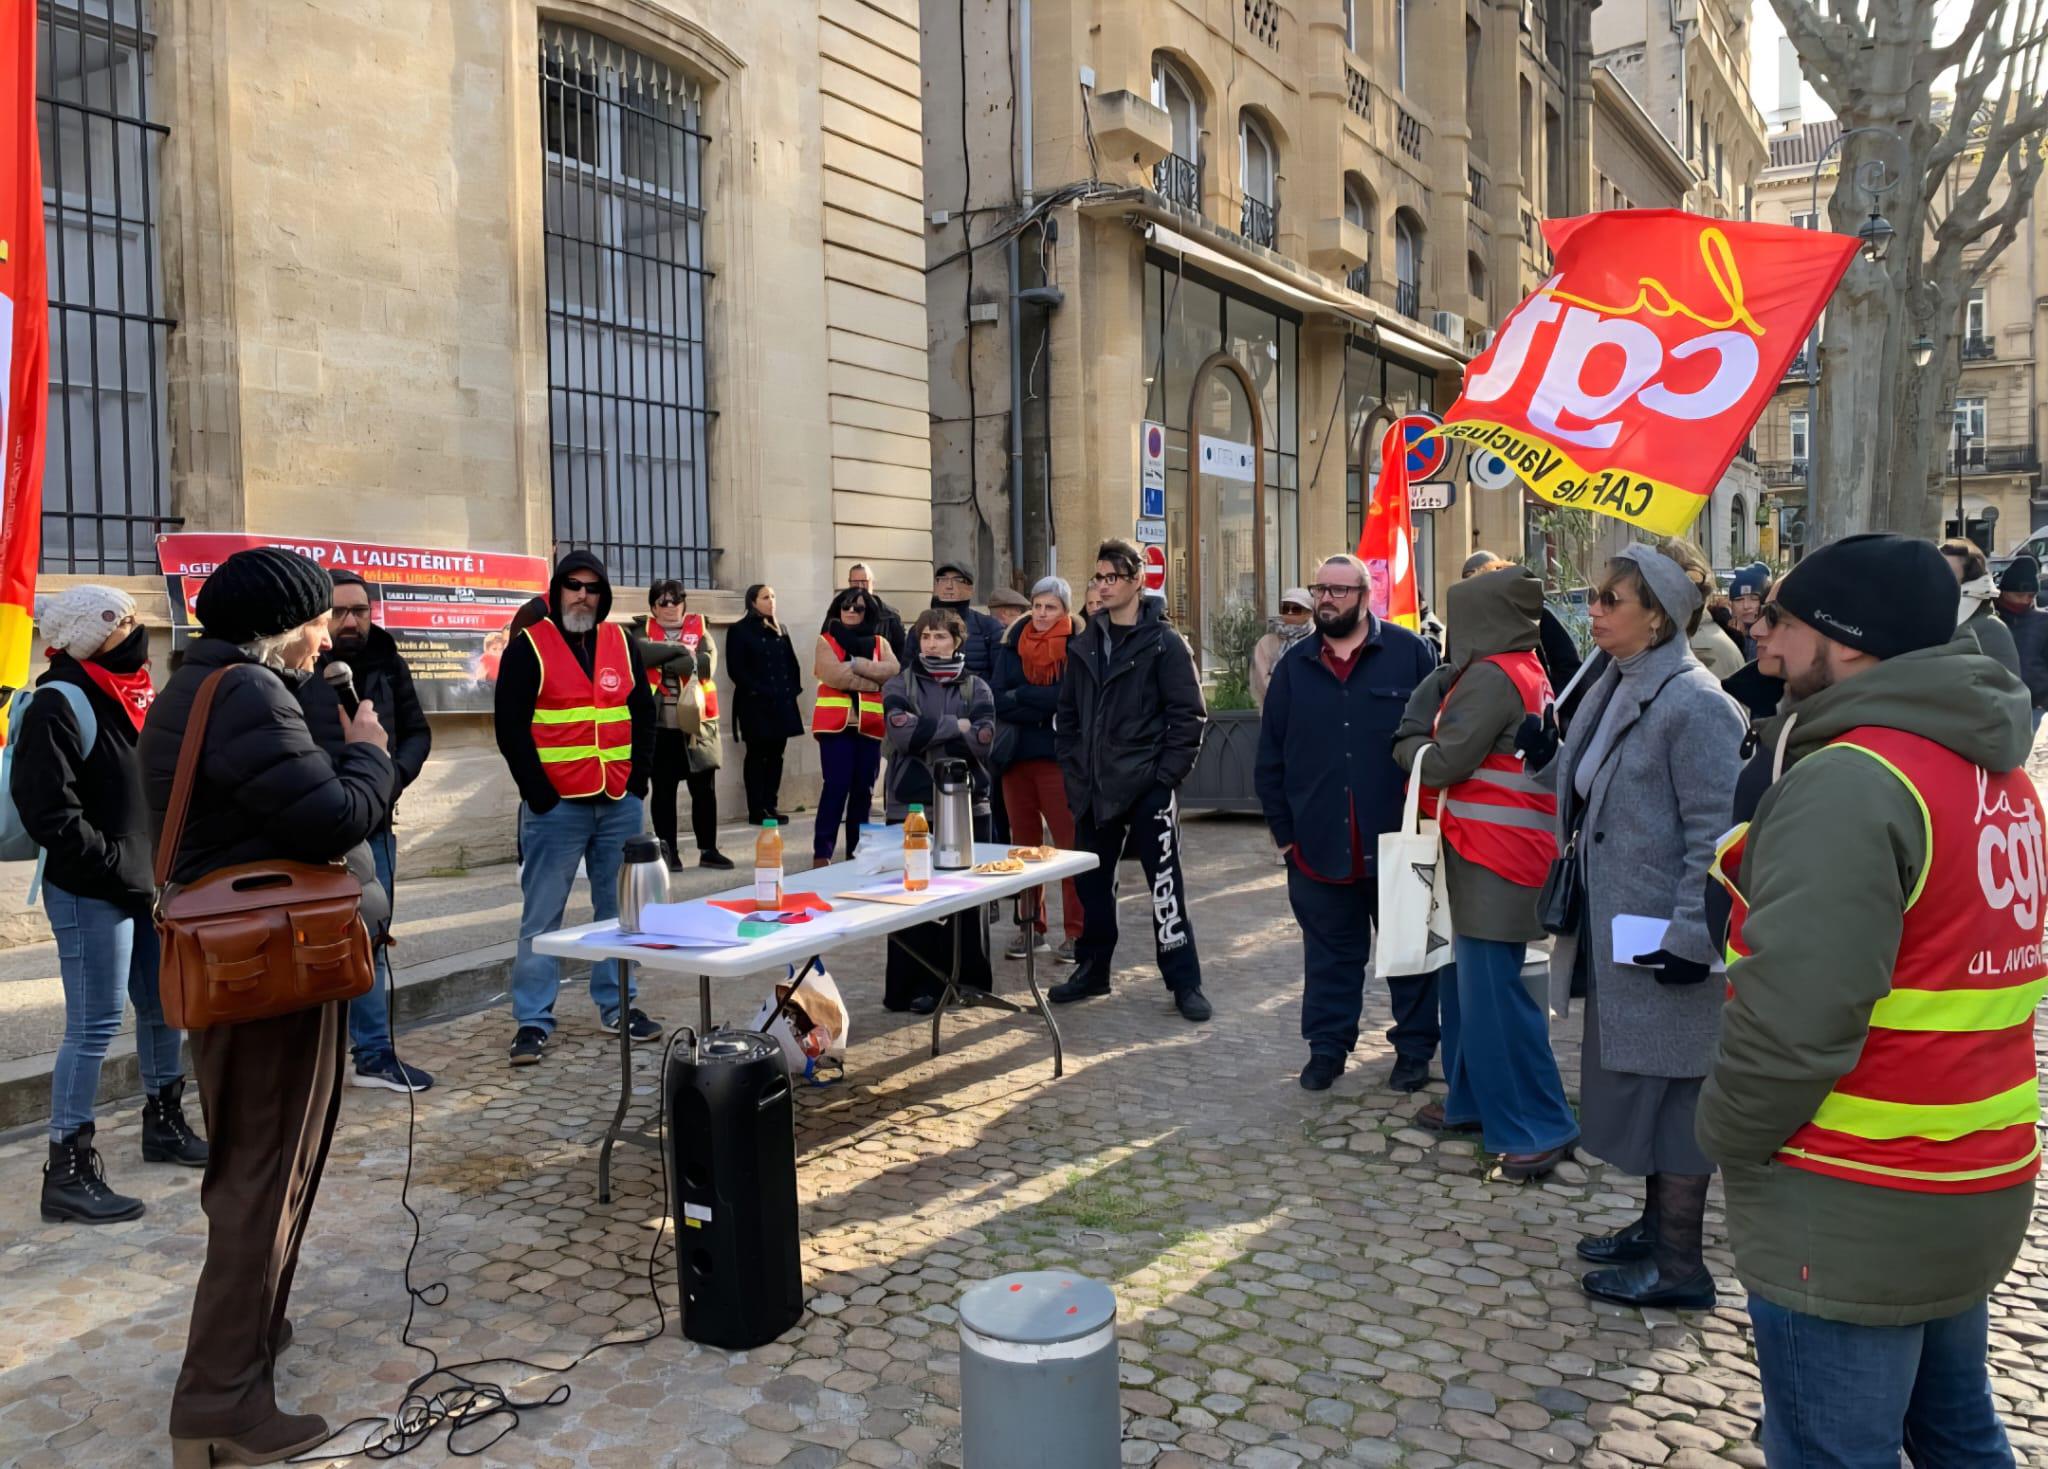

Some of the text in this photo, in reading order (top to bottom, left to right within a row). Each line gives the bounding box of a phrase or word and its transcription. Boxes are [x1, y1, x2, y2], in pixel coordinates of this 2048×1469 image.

[332, 544, 347, 564] À
[352, 550, 475, 572] L'AUSTÉRITÉ
[479, 559, 485, 572] !
[1977, 798, 2047, 930] cgt
[1968, 951, 2001, 975] UL
